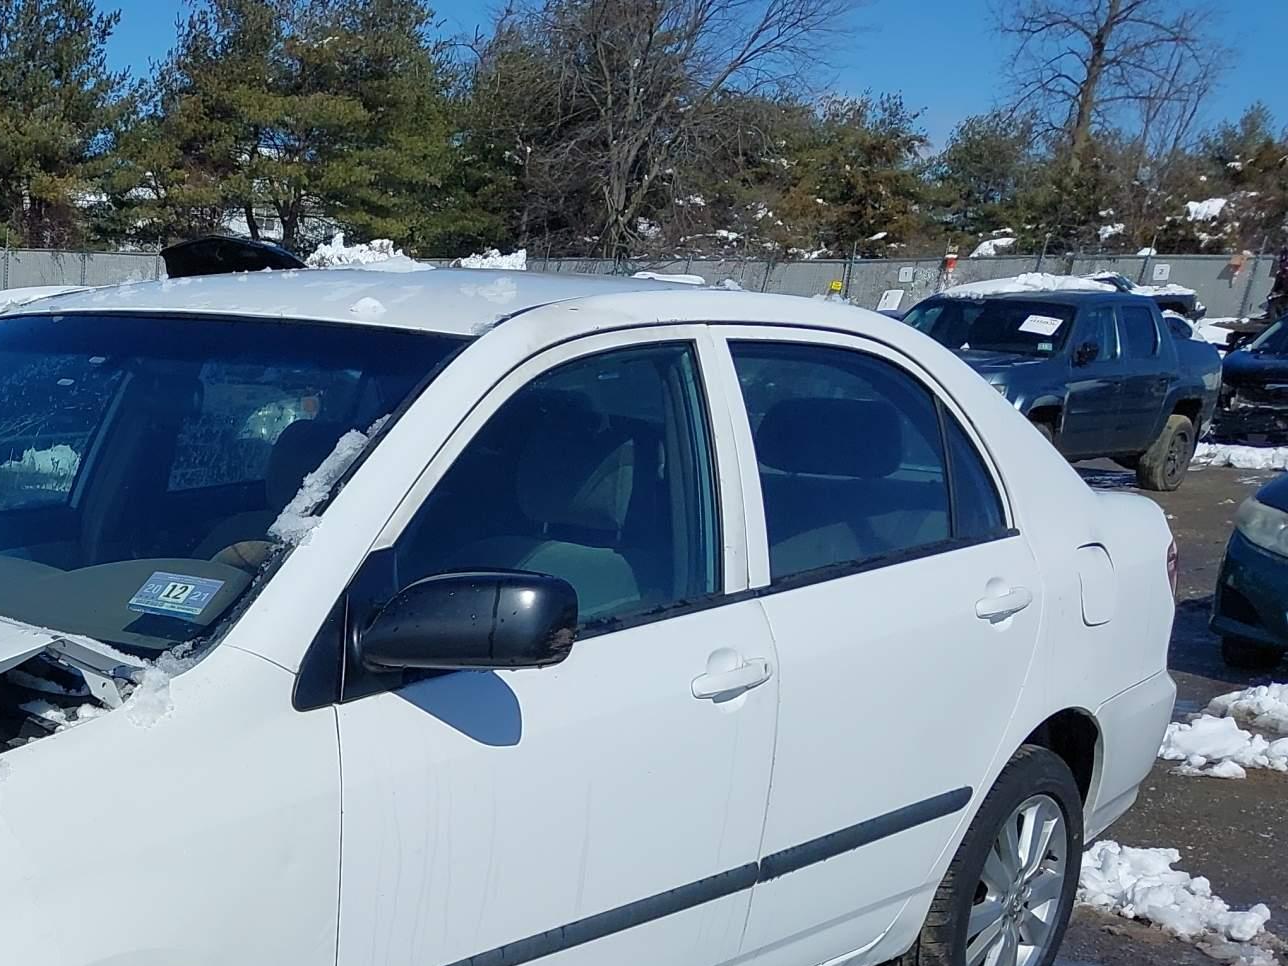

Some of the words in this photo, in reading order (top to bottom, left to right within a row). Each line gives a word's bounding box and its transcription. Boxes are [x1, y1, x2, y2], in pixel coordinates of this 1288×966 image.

[143, 583, 162, 594] 20
[163, 584, 189, 600] 12
[190, 591, 209, 601] 21
